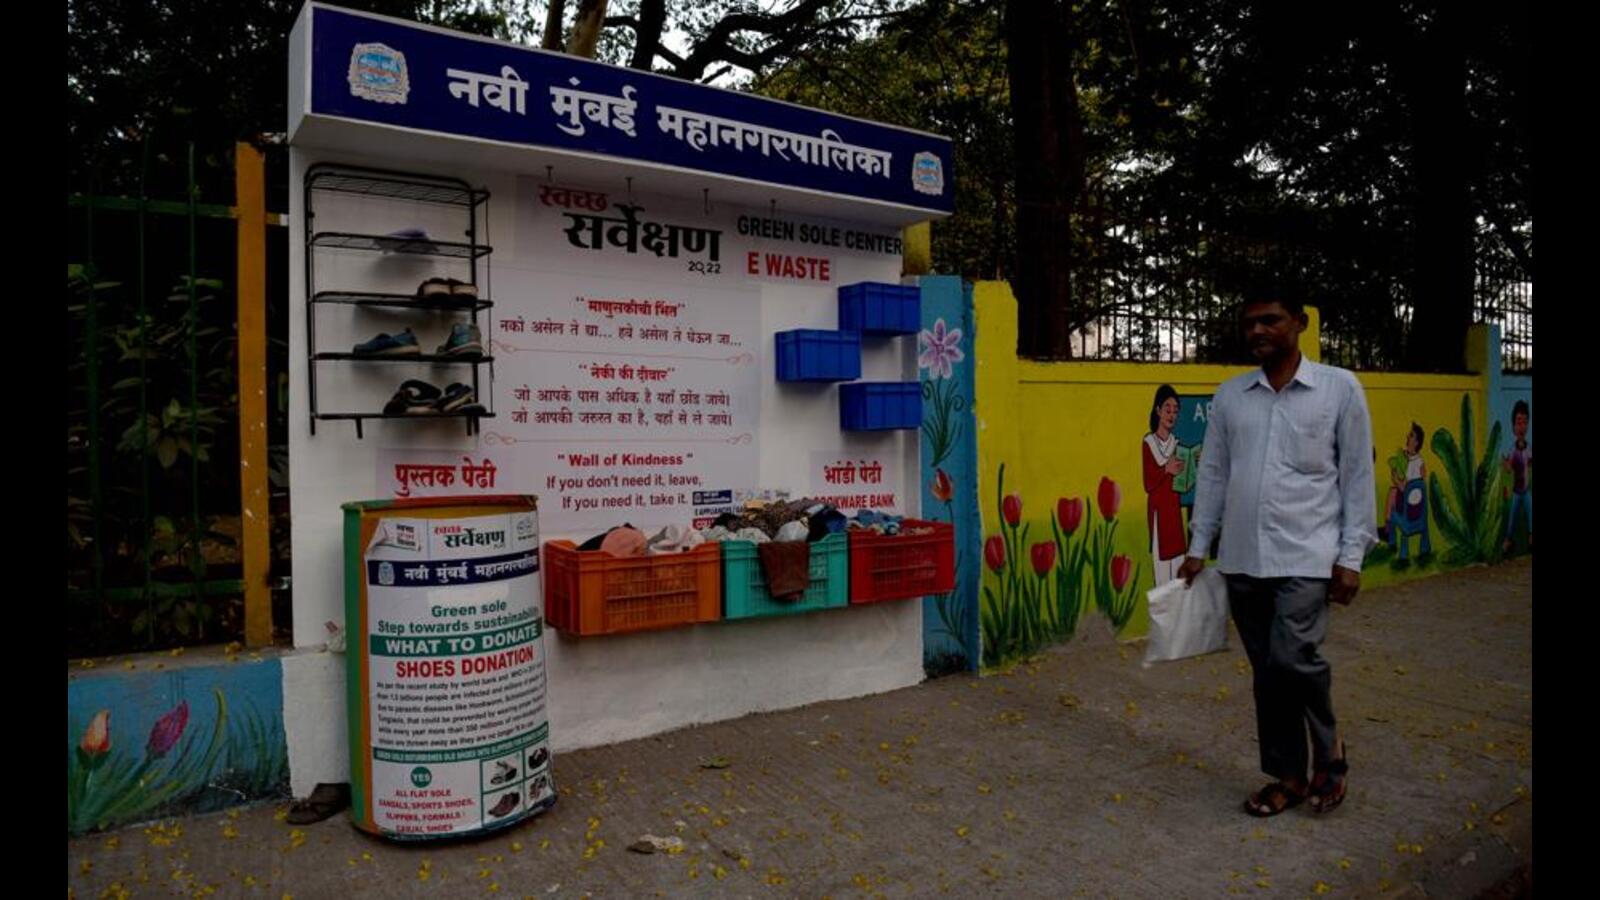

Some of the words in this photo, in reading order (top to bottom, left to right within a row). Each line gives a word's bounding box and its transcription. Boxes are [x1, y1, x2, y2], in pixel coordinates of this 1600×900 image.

[446, 65, 529, 116] नवी
[549, 76, 638, 137] मुंबई
[655, 104, 893, 180] महानगरपालिका
[538, 184, 608, 213] स्वच्छ
[563, 203, 723, 262] सर्वेक्षण
[737, 215, 794, 240] GREEN
[799, 223, 841, 247] SOLE
[845, 230, 902, 255] CENTER
[748, 252, 760, 275] E
[765, 253, 829, 281] WASTE
[500, 316, 525, 333] नको
[532, 318, 564, 335] असेल
[571, 320, 580, 336] ते
[619, 323, 634, 339] हवे
[640, 325, 668, 342] असेल
[673, 327, 682, 342] ते
[687, 328, 713, 344] घेऊन
[618, 364, 634, 381] की
[514, 384, 530, 401] जो
[538, 385, 571, 402] आपके
[577, 391, 599, 402] पास
[606, 387, 640, 403] अधिक
[645, 387, 652, 404] है
[512, 407, 528, 424] जो
[535, 406, 573, 424] आपकी
[617, 413, 632, 424] का
[678, 409, 688, 425] से
[692, 410, 702, 425] ले
[568, 454, 599, 467] Wall
[603, 454, 617, 466] of
[622, 454, 683, 467] Kindness
[394, 464, 456, 497] पुस्तक
[462, 456, 497, 488] पेढी
[546, 476, 556, 488] If
[559, 478, 583, 492] you
[586, 475, 619, 488] don't
[622, 474, 651, 487] need
[668, 474, 702, 488] leave,
[823, 460, 856, 485] भांडी
[860, 460, 882, 484] पेढी
[562, 496, 571, 509] If
[574, 498, 599, 511] you
[602, 494, 631, 507] need
[649, 493, 674, 506] take
[869, 493, 896, 508] BANK
[403, 563, 430, 581] नवी
[435, 561, 469, 584] मुंबई
[431, 605, 476, 618] Green
[480, 600, 507, 614] sole
[378, 620, 405, 635] Step
[410, 620, 470, 633] towards
[385, 639, 442, 655] WHAT
[447, 637, 476, 653] TO
[482, 623, 538, 650] DONATE
[396, 660, 455, 678] SHOES
[461, 645, 534, 676] DONATION
[412, 773, 432, 782] YES
[410, 790, 428, 798] FLAT
[430, 789, 451, 797] SOLE
